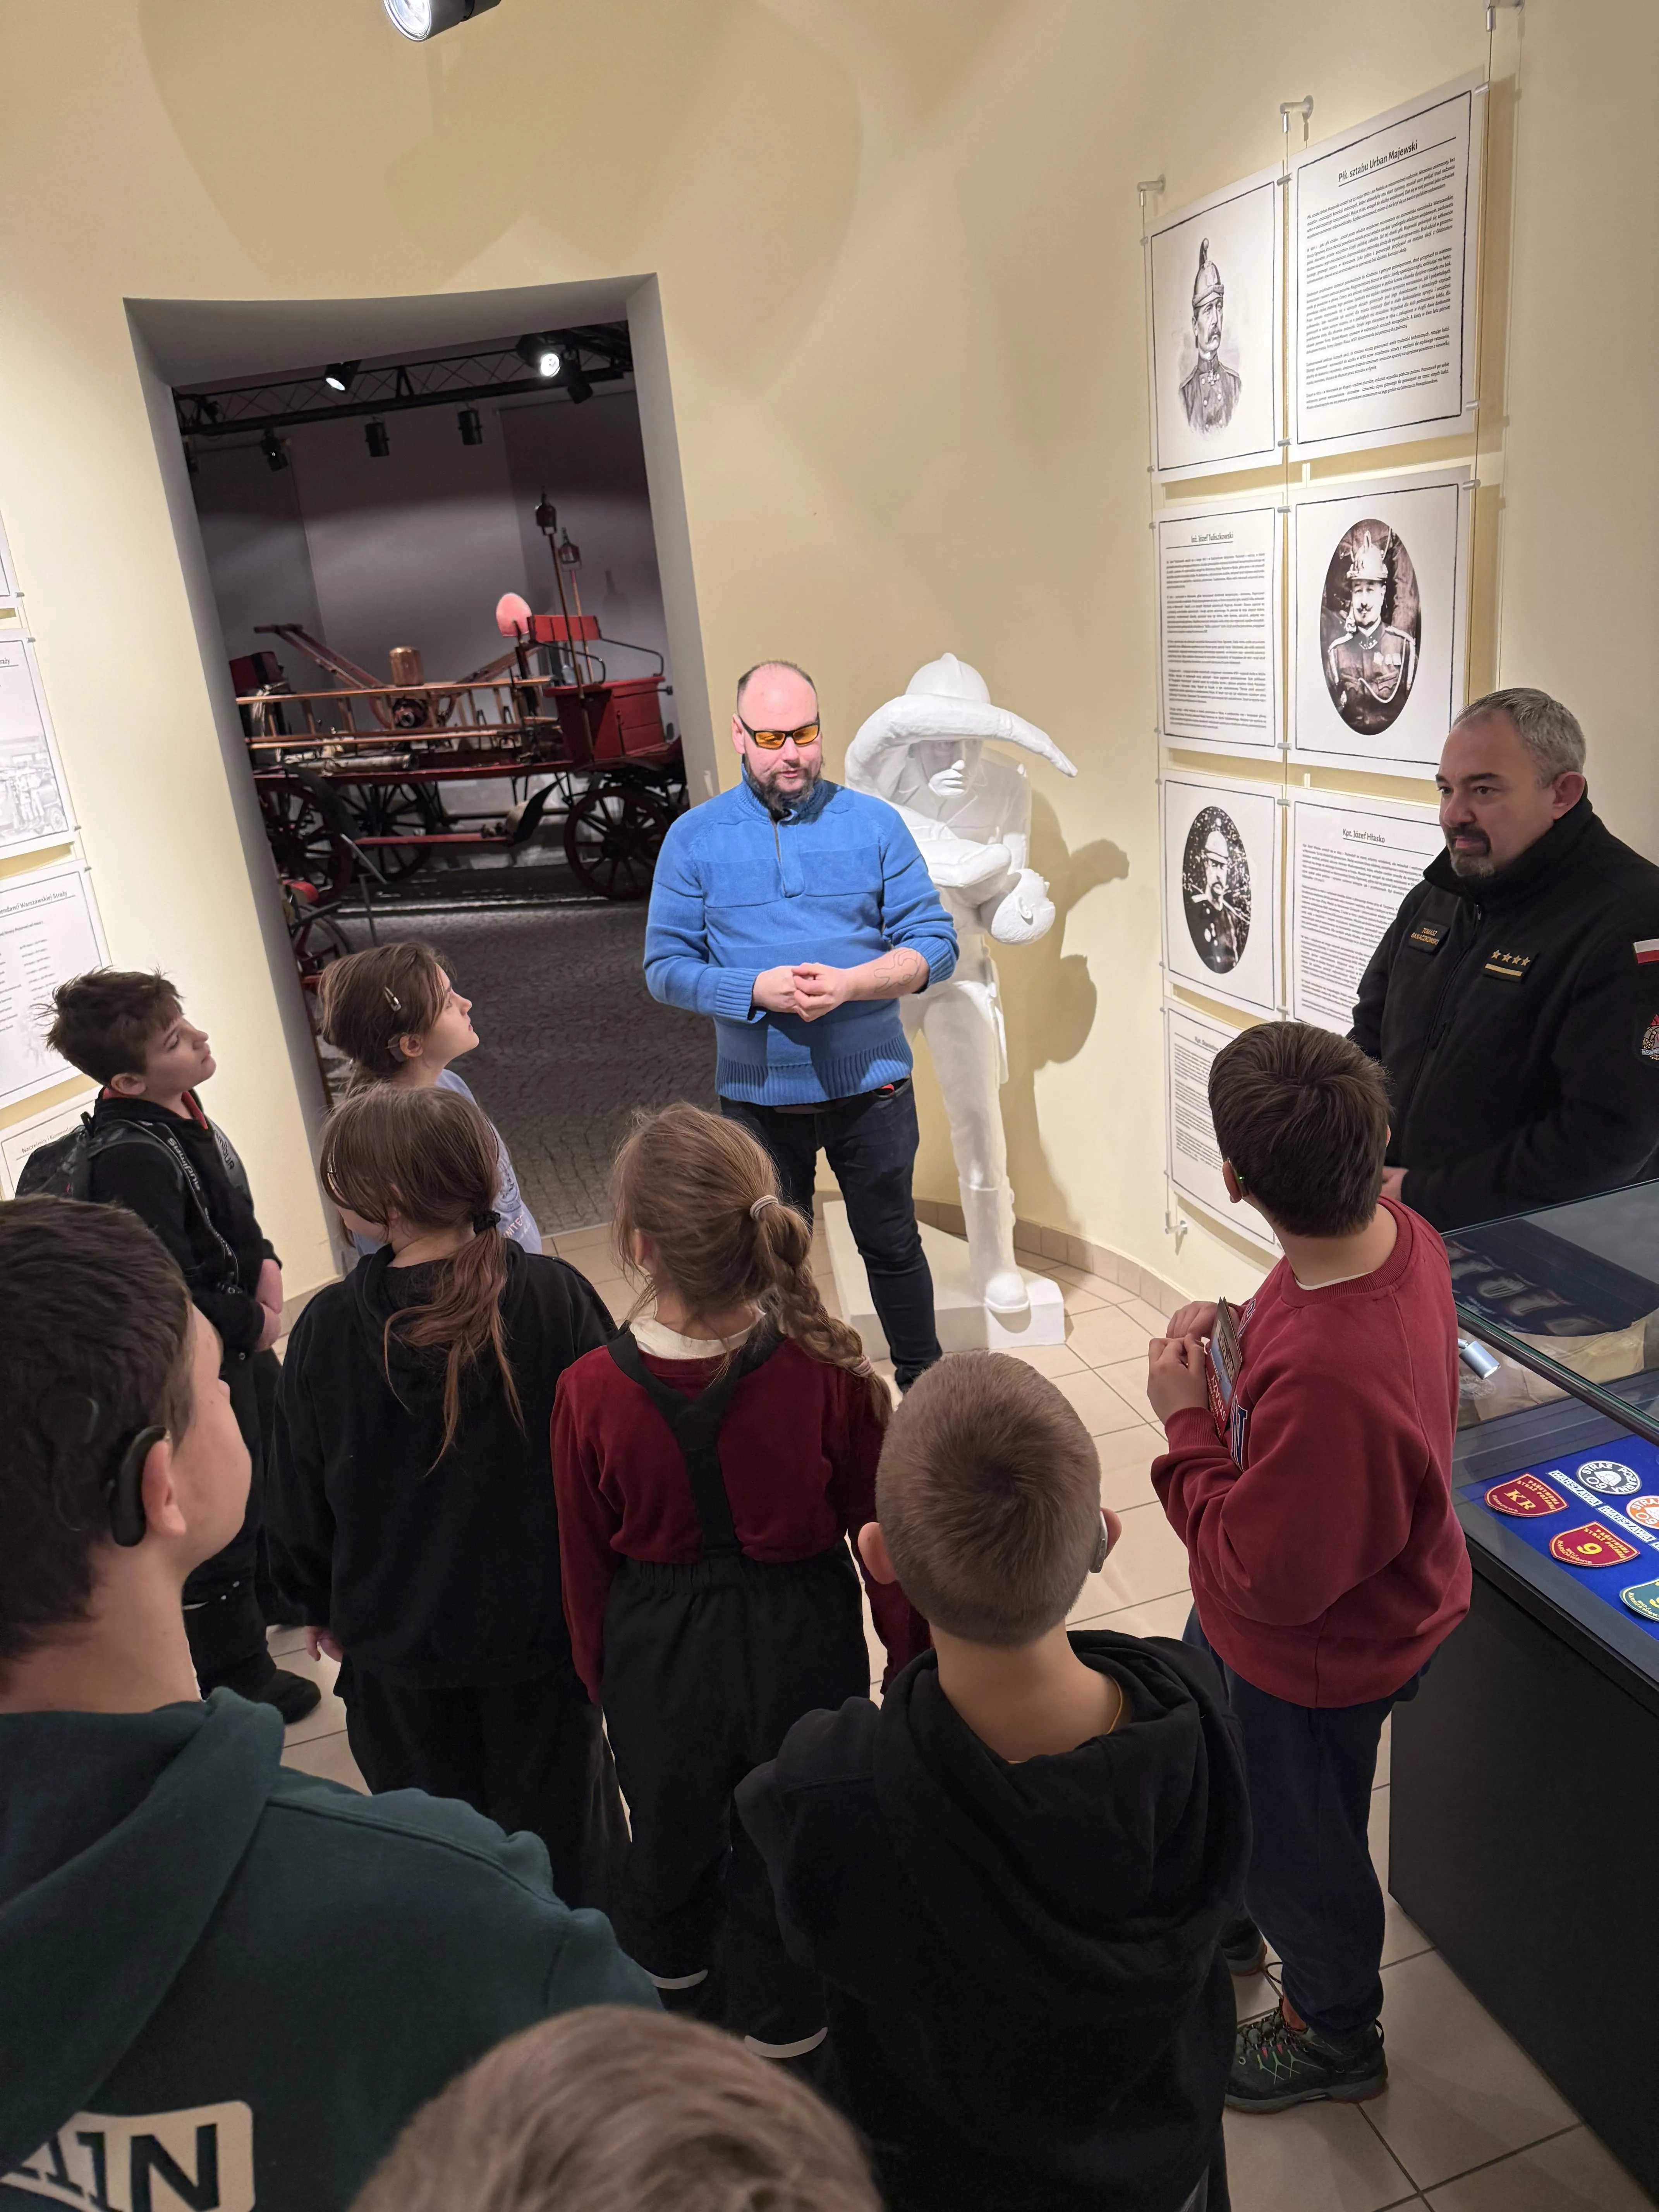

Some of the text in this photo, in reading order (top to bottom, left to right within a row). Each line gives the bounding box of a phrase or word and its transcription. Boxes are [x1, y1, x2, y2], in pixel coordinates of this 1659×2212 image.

[1338, 139, 1418, 182] Płk. sztabu Urban Majewski
[1343, 828, 1385, 843] Kpt. Józef Hłasko
[1551, 1472, 1600, 1505] WARSZAWA
[1504, 1489, 1536, 1510] KR
[1631, 1498, 1659, 1510] STRA
[1601, 1506, 1653, 1540] WARSZAWA
[1577, 1543, 1602, 1554] 9
